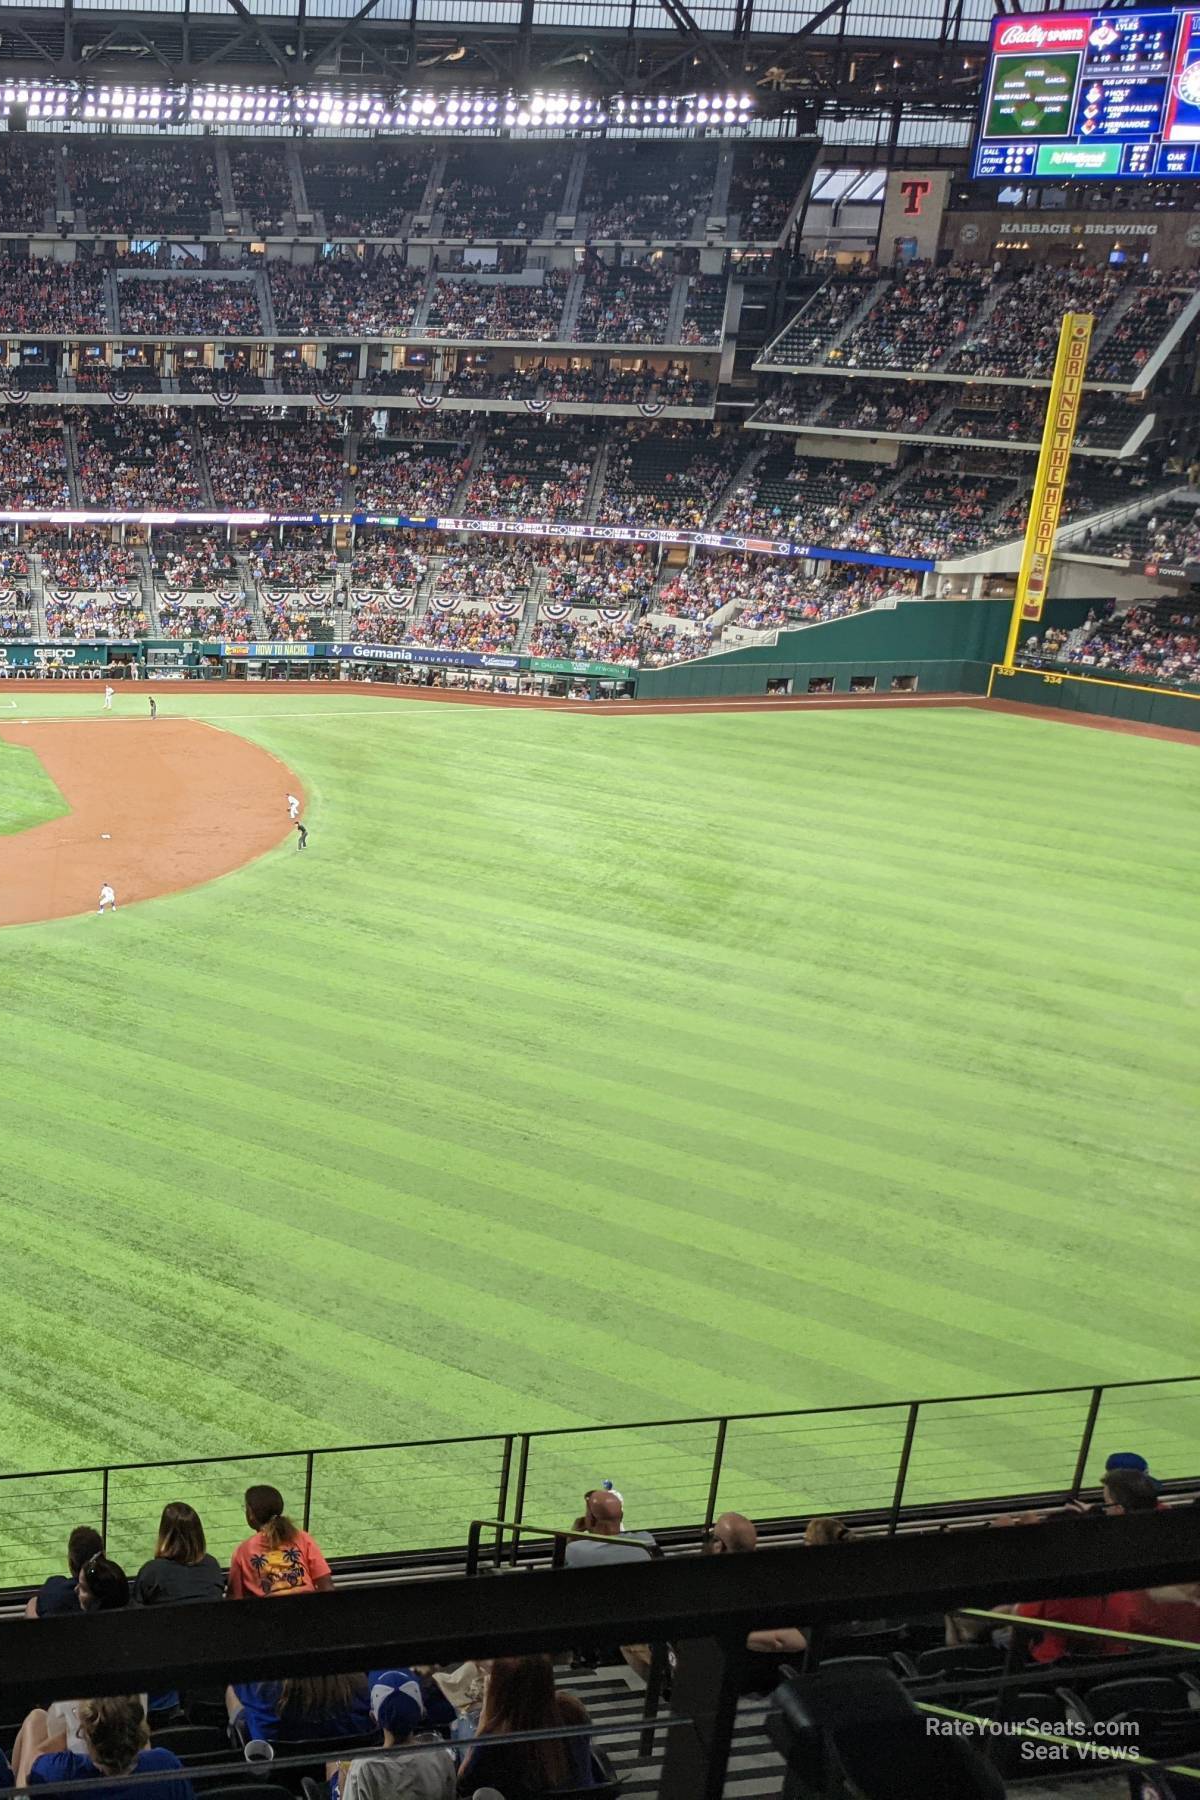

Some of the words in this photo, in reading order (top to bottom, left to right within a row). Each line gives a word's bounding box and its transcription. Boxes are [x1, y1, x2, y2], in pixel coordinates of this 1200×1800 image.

[1115, 22, 1139, 31] LYLES
[1000, 25, 1048, 47] Bally
[1047, 29, 1084, 42] SPORTS
[1167, 163, 1183, 171] TEX
[901, 179, 932, 214] T
[1000, 224, 1070, 234] KARBACH
[1084, 224, 1158, 235] BREWING
[1059, 342, 1084, 428] BRING
[1050, 433, 1069, 483] THE
[1038, 489, 1058, 553] HEAT
[793, 546, 809, 554] 7:21
[1159, 568, 1186, 576] TOYOTA
[34, 649, 75, 658] GEICO
[256, 645, 272, 655] HOW
[274, 645, 283, 655] TO
[353, 646, 412, 660] Germania
[414, 655, 465, 664] INSURANCE
[997, 667, 1015, 676] 329
[1043, 675, 1064, 684] 334
